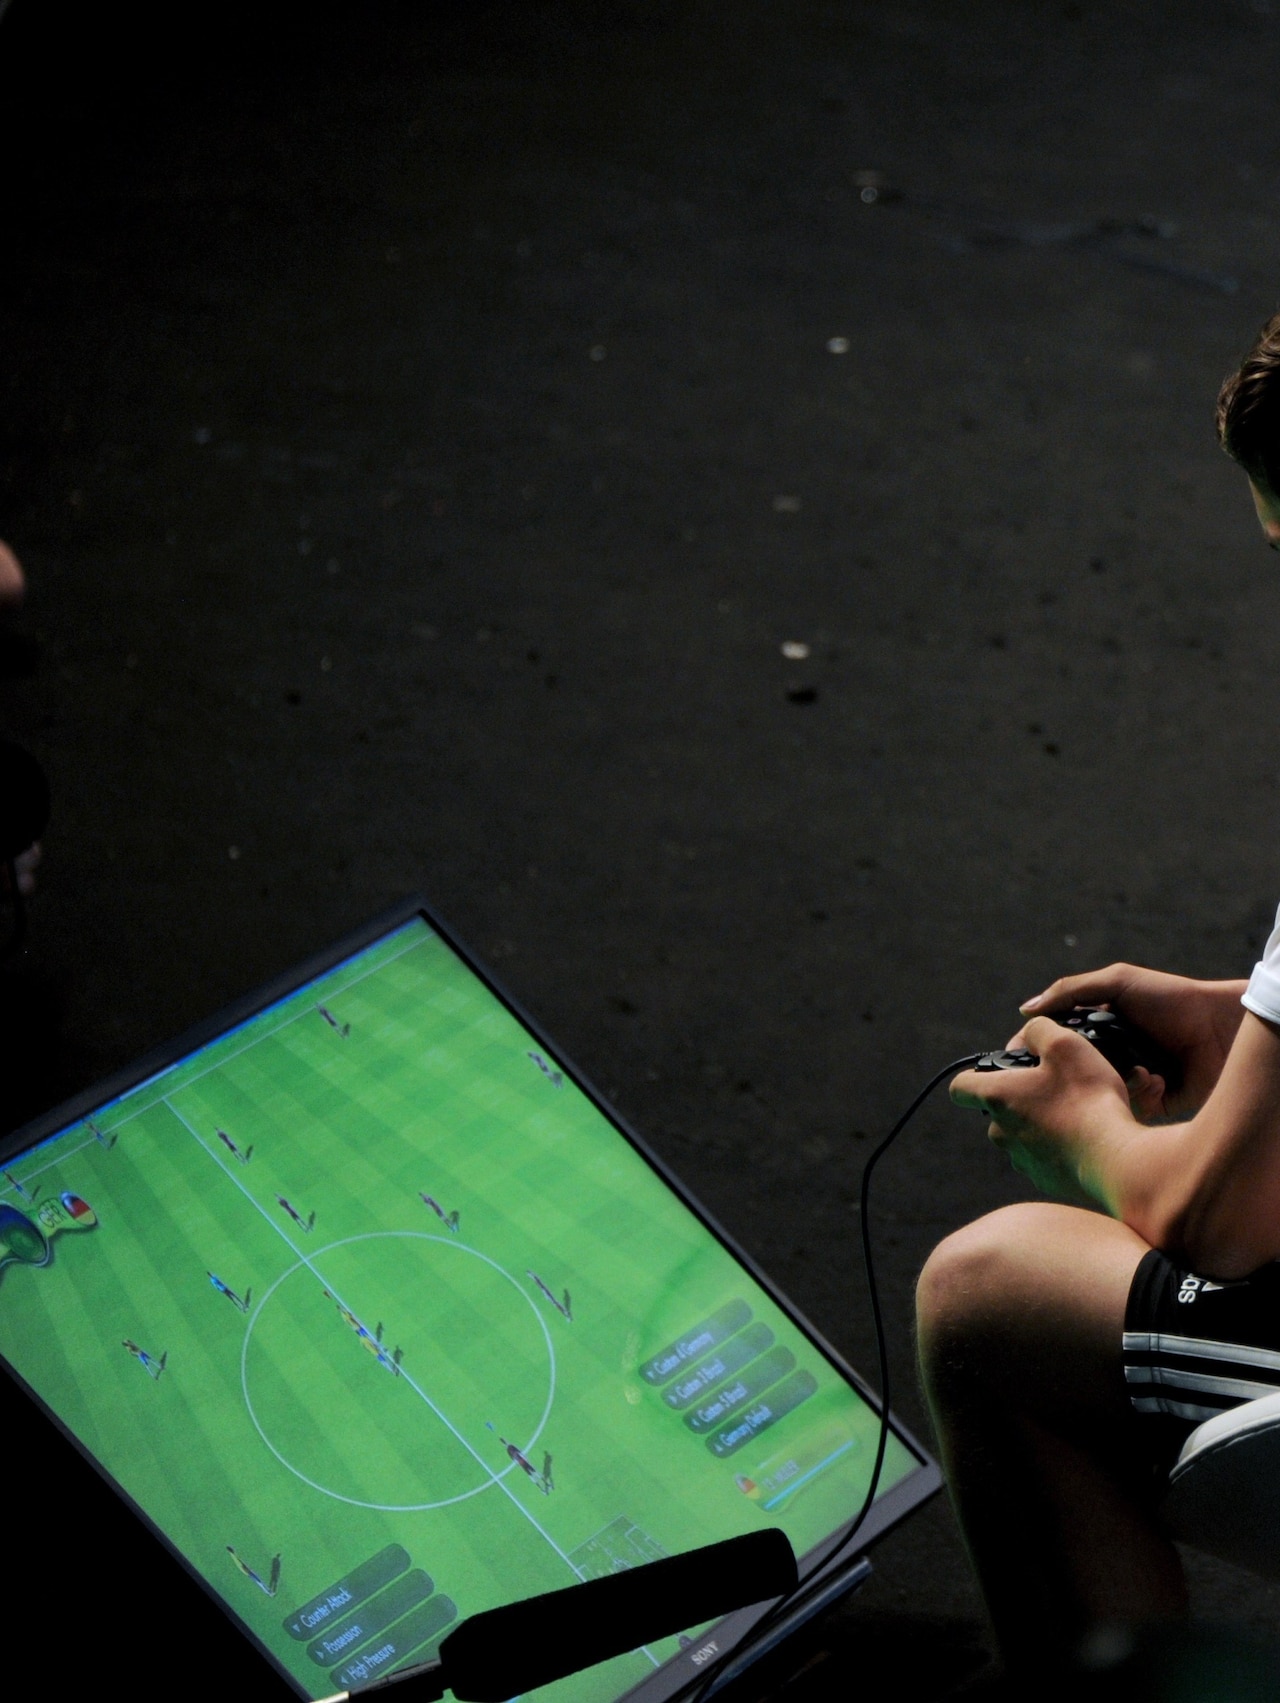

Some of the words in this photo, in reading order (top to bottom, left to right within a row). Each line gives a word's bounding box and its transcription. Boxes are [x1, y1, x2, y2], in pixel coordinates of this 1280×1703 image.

[38, 1203, 68, 1228] GER
[300, 1604, 331, 1628] Counter
[326, 1587, 353, 1611] Attack
[322, 1625, 363, 1654] Possession
[691, 1641, 718, 1665] SONY
[346, 1660, 369, 1680] High
[362, 1644, 396, 1669] Pressure
